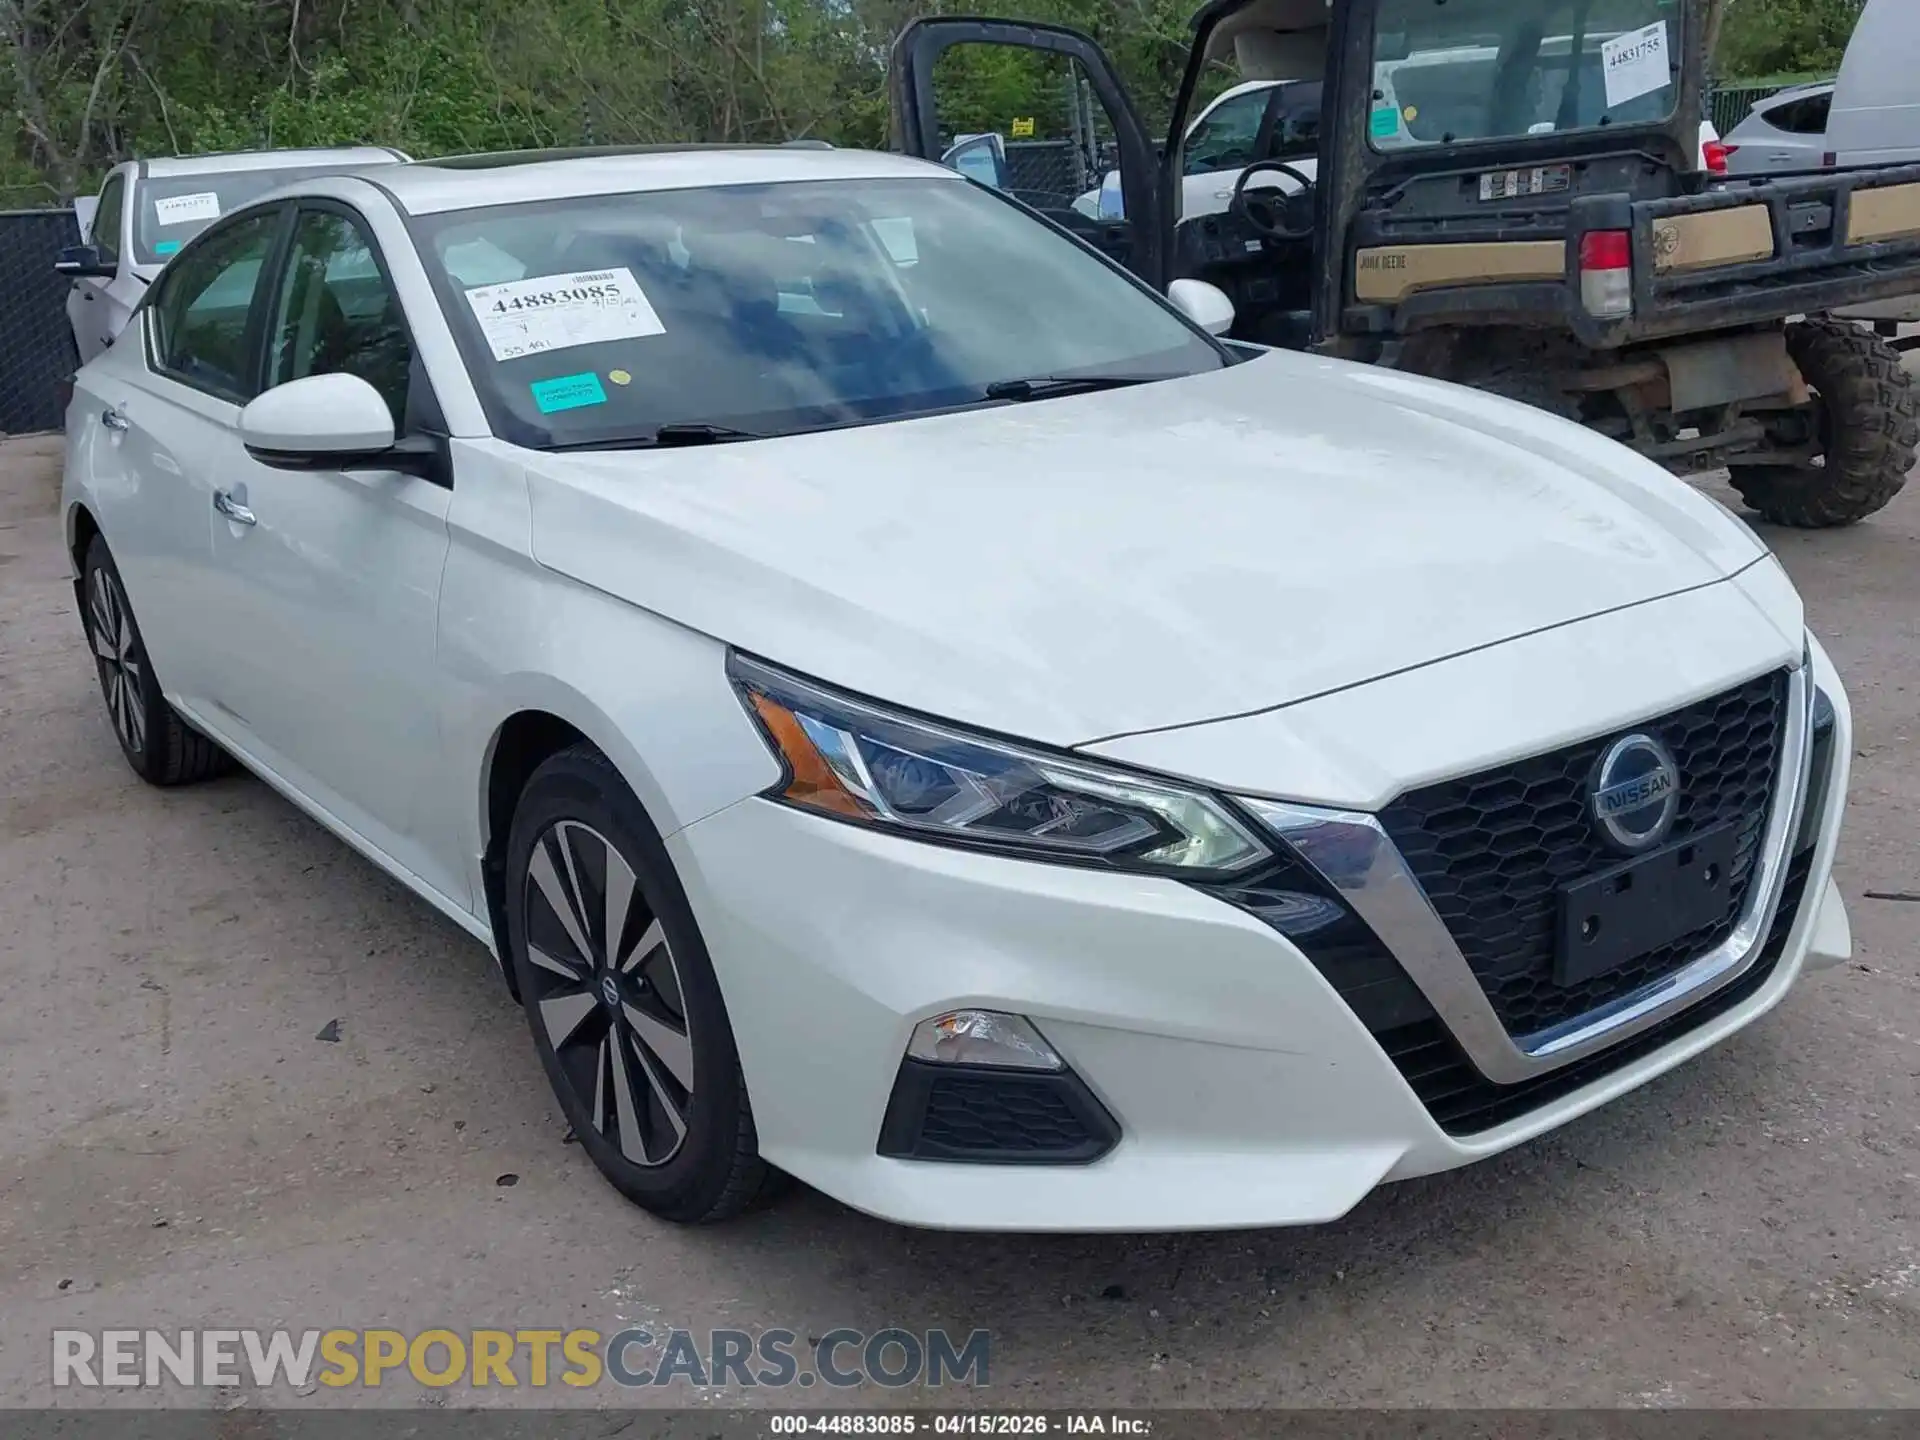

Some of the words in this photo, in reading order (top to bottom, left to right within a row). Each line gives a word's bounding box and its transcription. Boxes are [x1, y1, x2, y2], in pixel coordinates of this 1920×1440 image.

[1610, 37, 1660, 67] 44831755
[492, 283, 621, 313] 44883085
[1606, 771, 1671, 810] NISSAN
